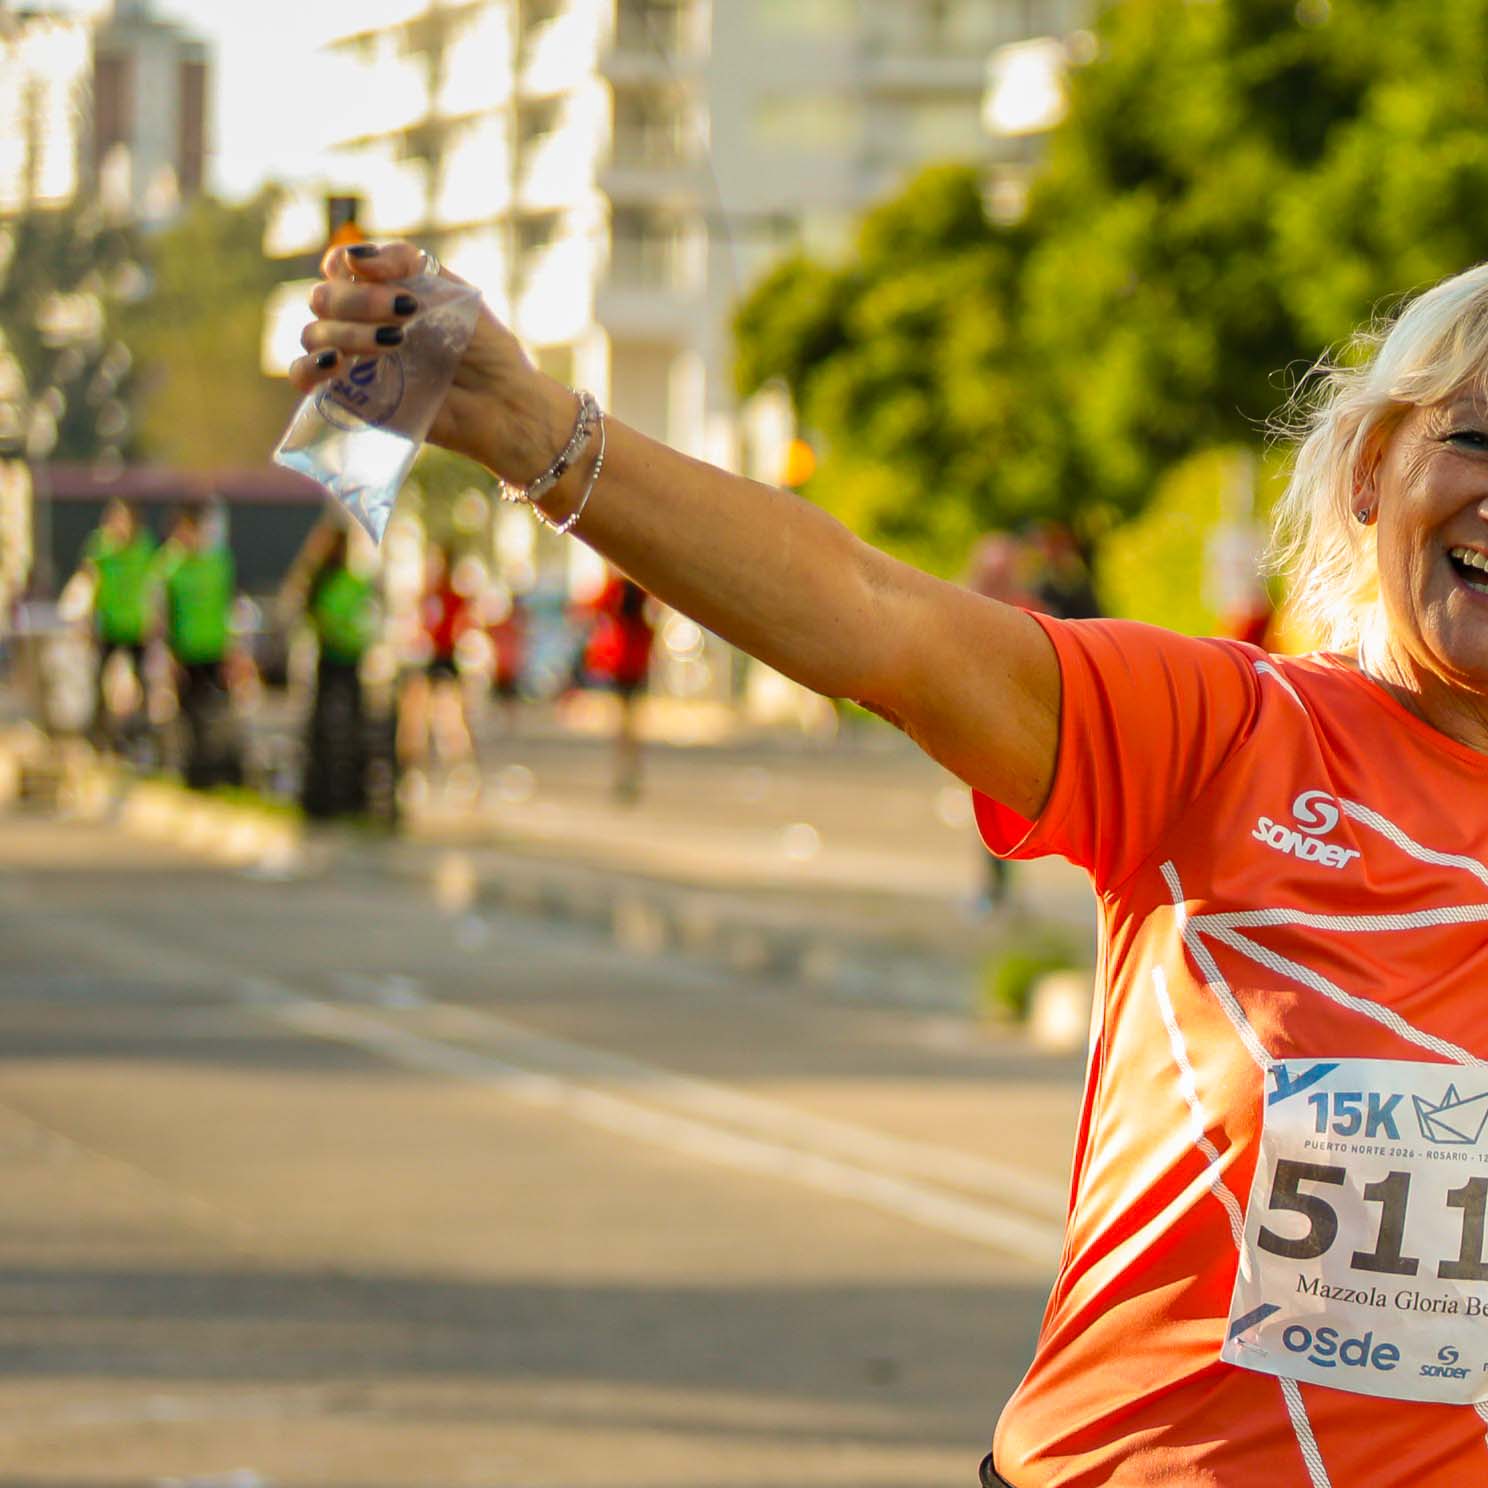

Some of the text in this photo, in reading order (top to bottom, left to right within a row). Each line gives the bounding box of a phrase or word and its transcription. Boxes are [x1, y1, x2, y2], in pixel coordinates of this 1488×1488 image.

[1308, 1091, 1404, 1141] 15K
[1304, 1139, 1348, 1153] PUERTO
[1351, 1144, 1386, 1156] NORTE
[1390, 1148, 1415, 1158] 2026
[1426, 1150, 1468, 1161] ROSARIO
[1479, 1154, 1488, 1163] 12
[1296, 1274, 1387, 1308] Mazzola
[1395, 1290, 1459, 1314] Gloria
[1282, 1325, 1401, 1371] osde
